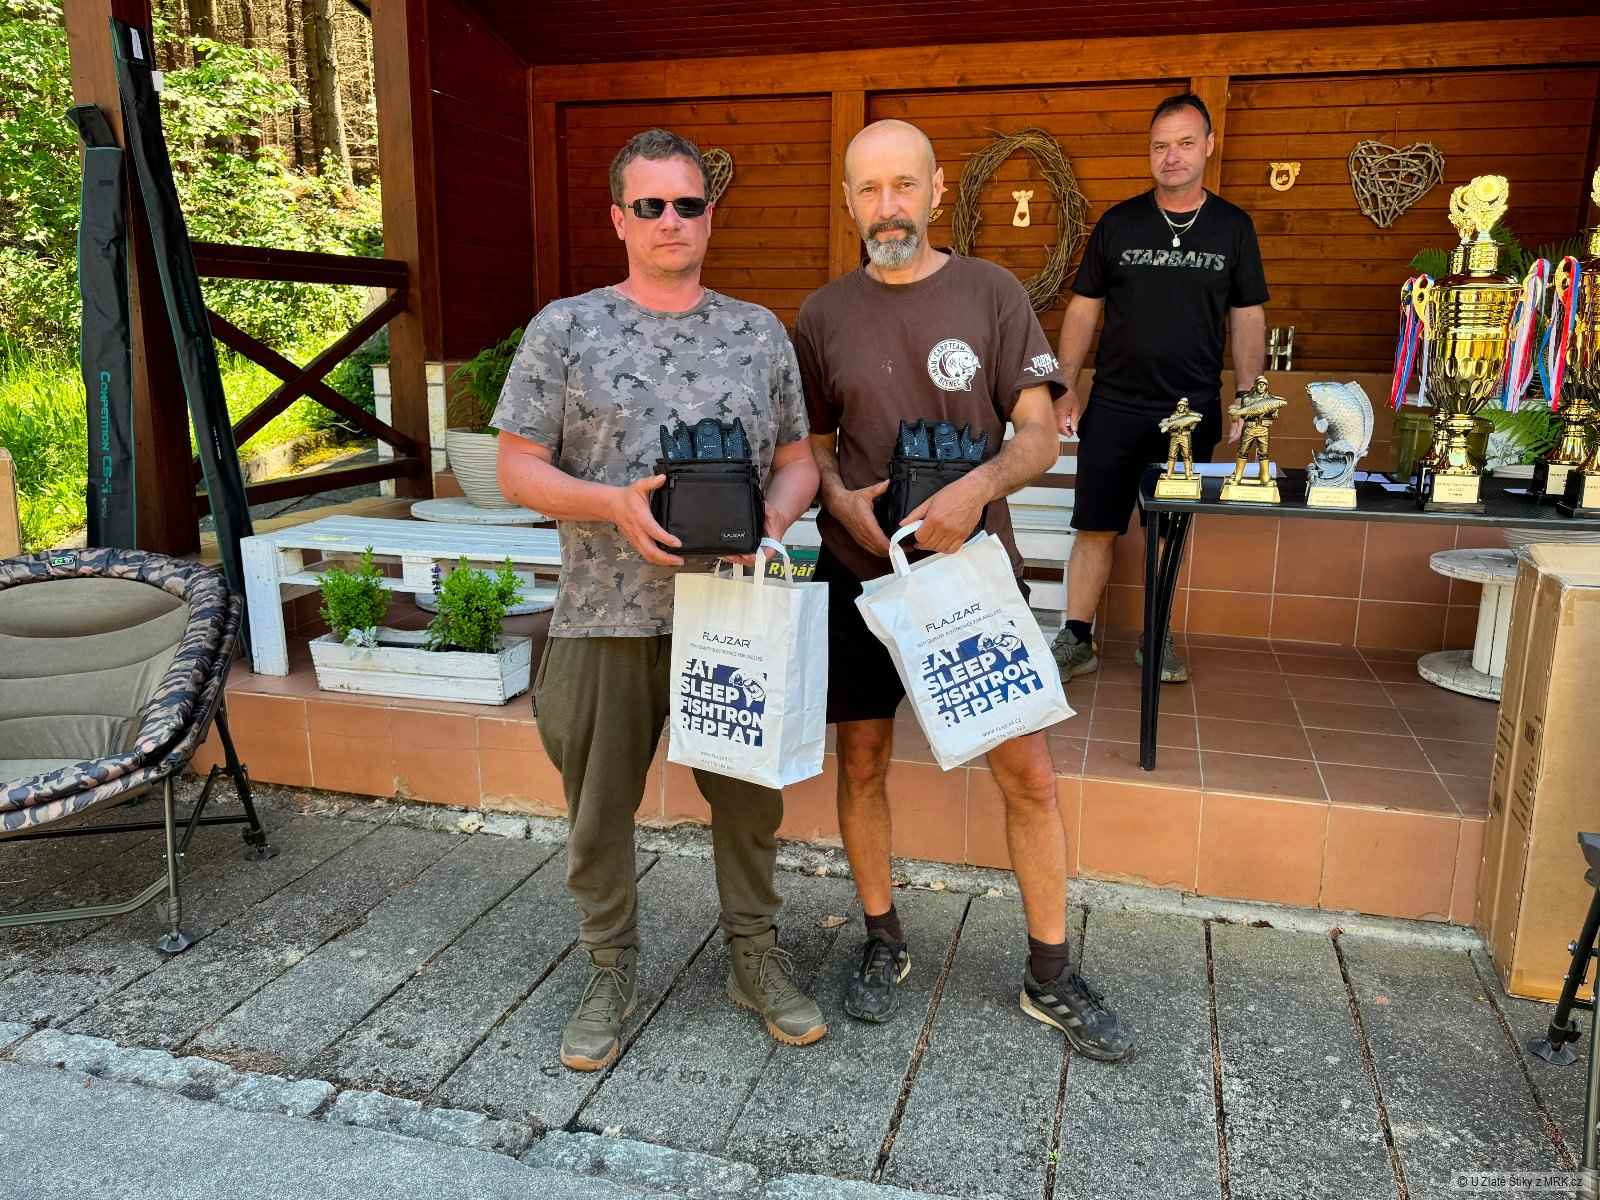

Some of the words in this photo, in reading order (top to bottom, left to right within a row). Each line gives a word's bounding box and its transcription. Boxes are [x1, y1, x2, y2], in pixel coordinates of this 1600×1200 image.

[925, 602, 983, 633] FLAJZAR
[702, 631, 751, 649] FLAJZAR
[681, 658, 717, 681] EAT
[925, 651, 997, 696] SLEEP
[934, 658, 1037, 714] FISHTRON
[680, 675, 740, 704] SLEEP
[940, 673, 1038, 731] REPEAT
[680, 694, 764, 729] FISHTRON
[680, 711, 762, 748] REPEAT
